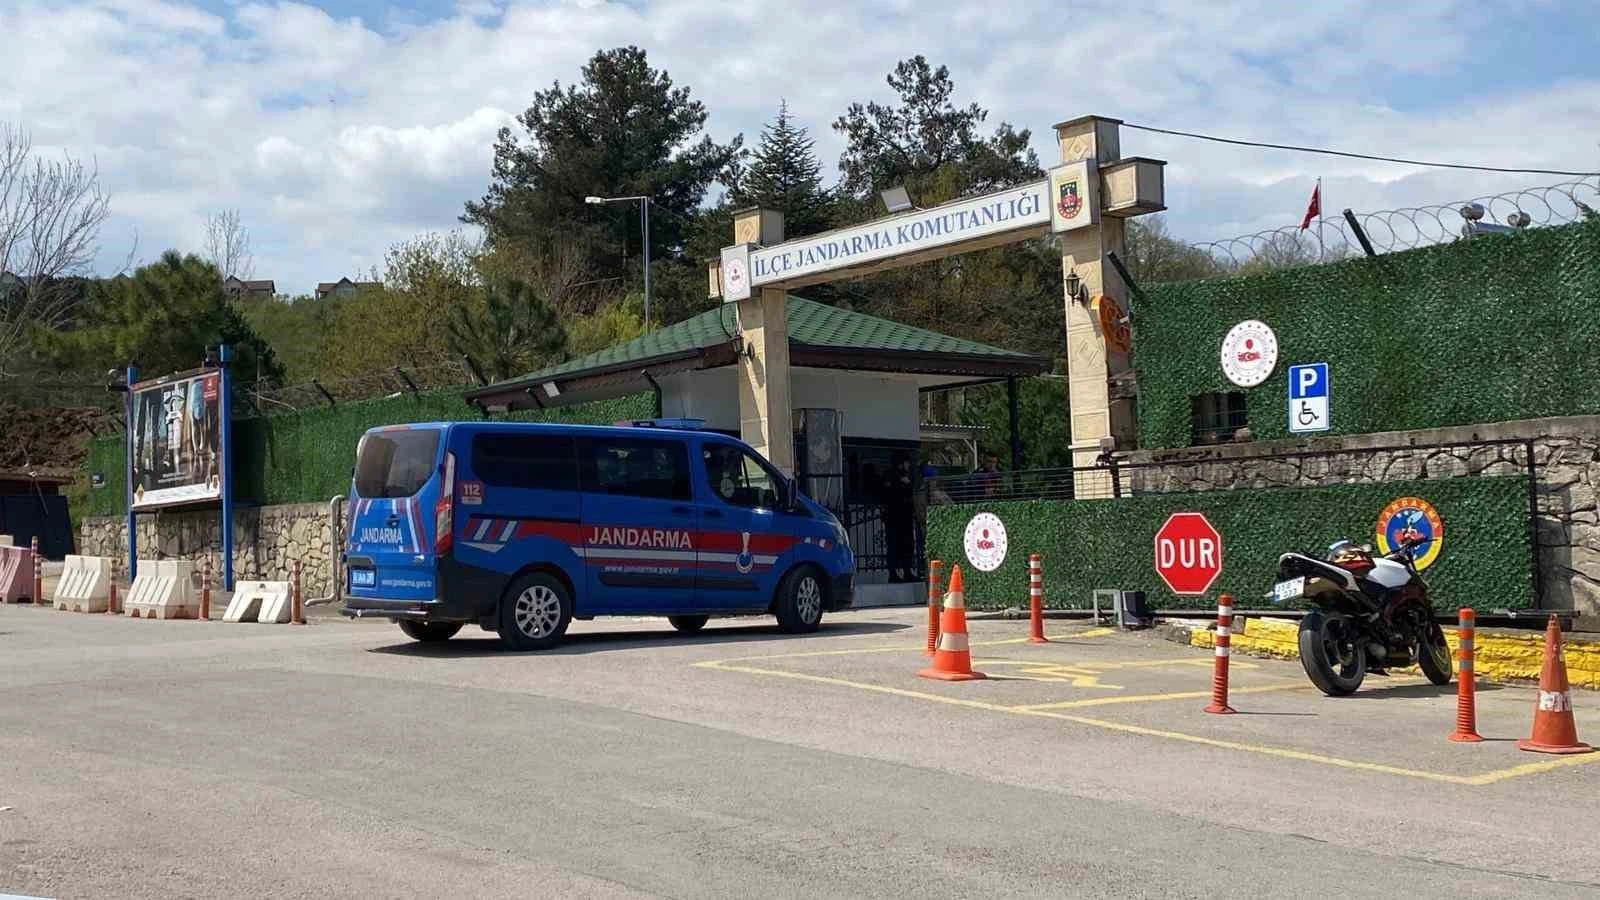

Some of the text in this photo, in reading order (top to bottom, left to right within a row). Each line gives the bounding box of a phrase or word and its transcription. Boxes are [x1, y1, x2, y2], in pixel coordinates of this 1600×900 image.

[754, 252, 793, 277] İLÇE
[796, 229, 893, 267] JANDARMA
[897, 191, 1041, 243] KOMUTANLIĞI
[1299, 368, 1318, 396] P
[463, 483, 480, 496] 112
[360, 527, 403, 544] JANDARMA
[588, 526, 693, 549] JANDARMA
[1160, 538, 1216, 569] DUR
